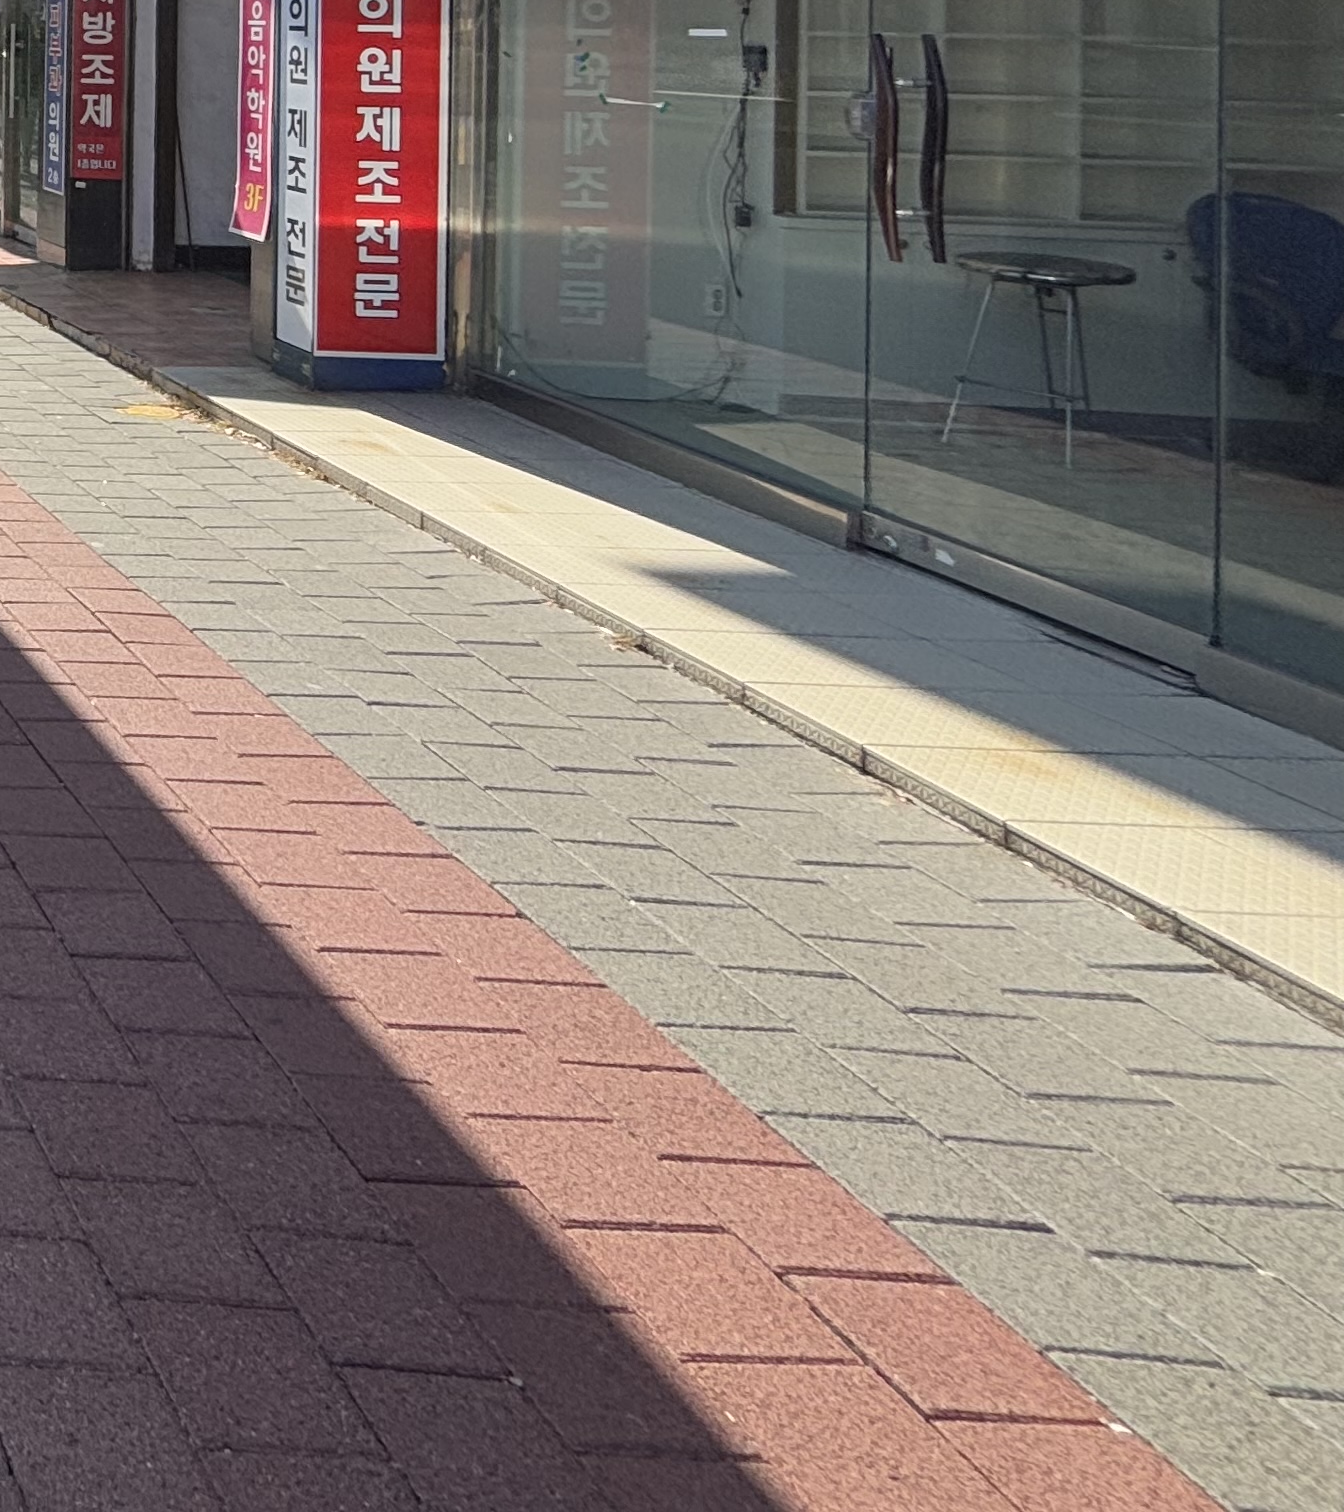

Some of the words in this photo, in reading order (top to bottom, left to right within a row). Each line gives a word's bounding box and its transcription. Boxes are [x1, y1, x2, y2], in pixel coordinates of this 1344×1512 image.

[287, 107, 308, 194] 제조
[244, 182, 264, 213] 3F
[285, 217, 306, 306] 전문
